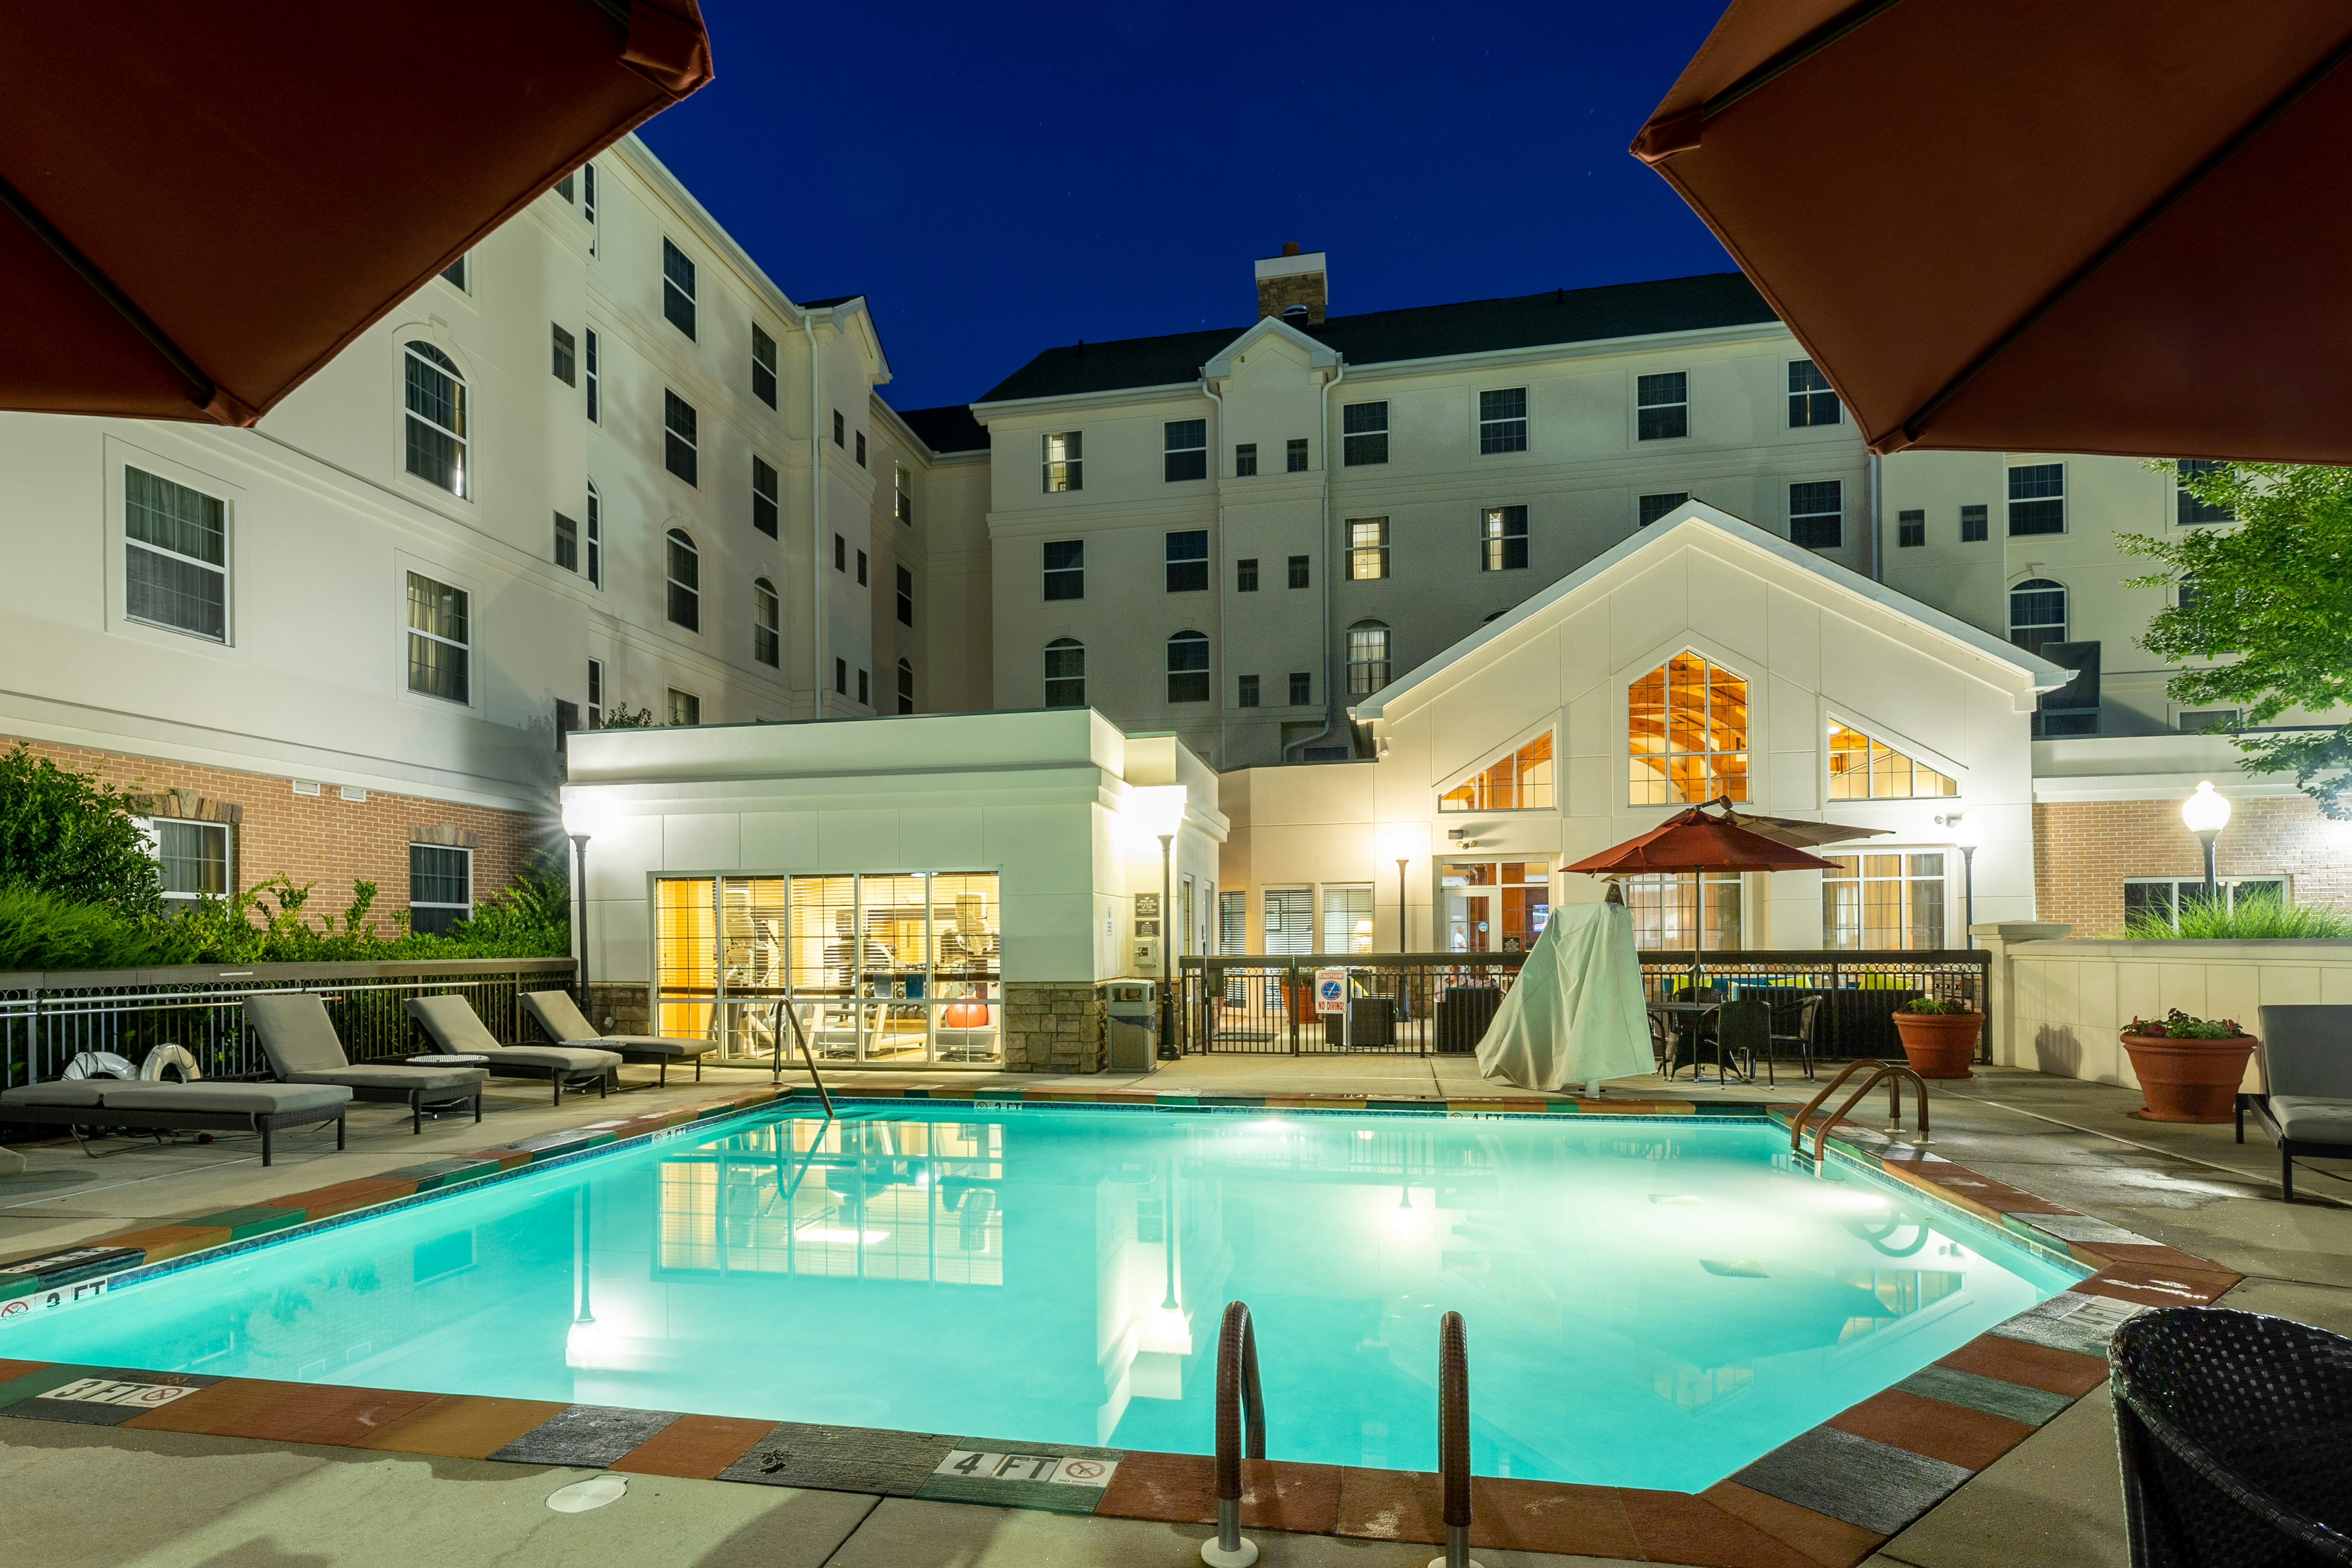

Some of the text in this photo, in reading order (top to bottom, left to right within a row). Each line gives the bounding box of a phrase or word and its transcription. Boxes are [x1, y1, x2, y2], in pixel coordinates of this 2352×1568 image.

[1318, 1001, 1344, 1010] NO DIVING!
[74, 1280, 106, 1301] FT
[54, 1381, 156, 1402] 3 FT
[953, 1453, 1058, 1478] 4 FT
